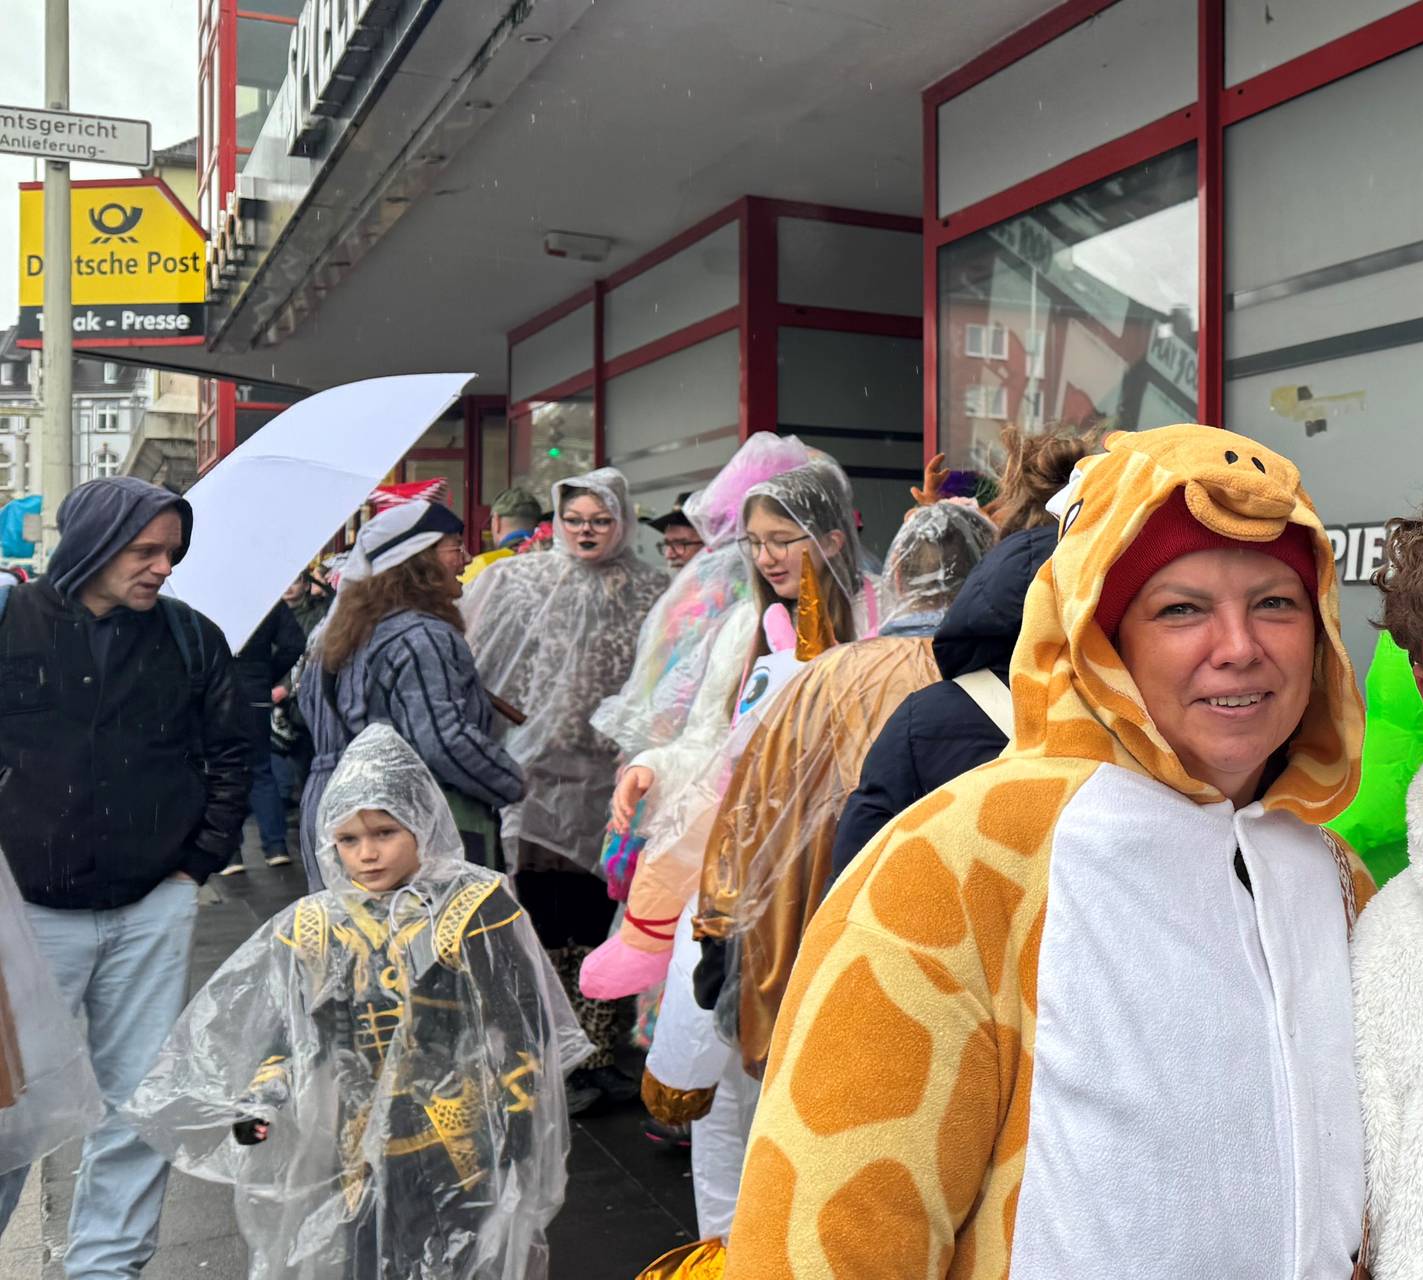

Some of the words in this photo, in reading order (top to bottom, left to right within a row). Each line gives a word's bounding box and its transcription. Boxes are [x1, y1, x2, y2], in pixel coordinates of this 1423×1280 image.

[26, 250, 139, 277] Dtsche
[147, 251, 200, 274] Post
[36, 310, 103, 332] Tak
[121, 310, 191, 331] Presse
